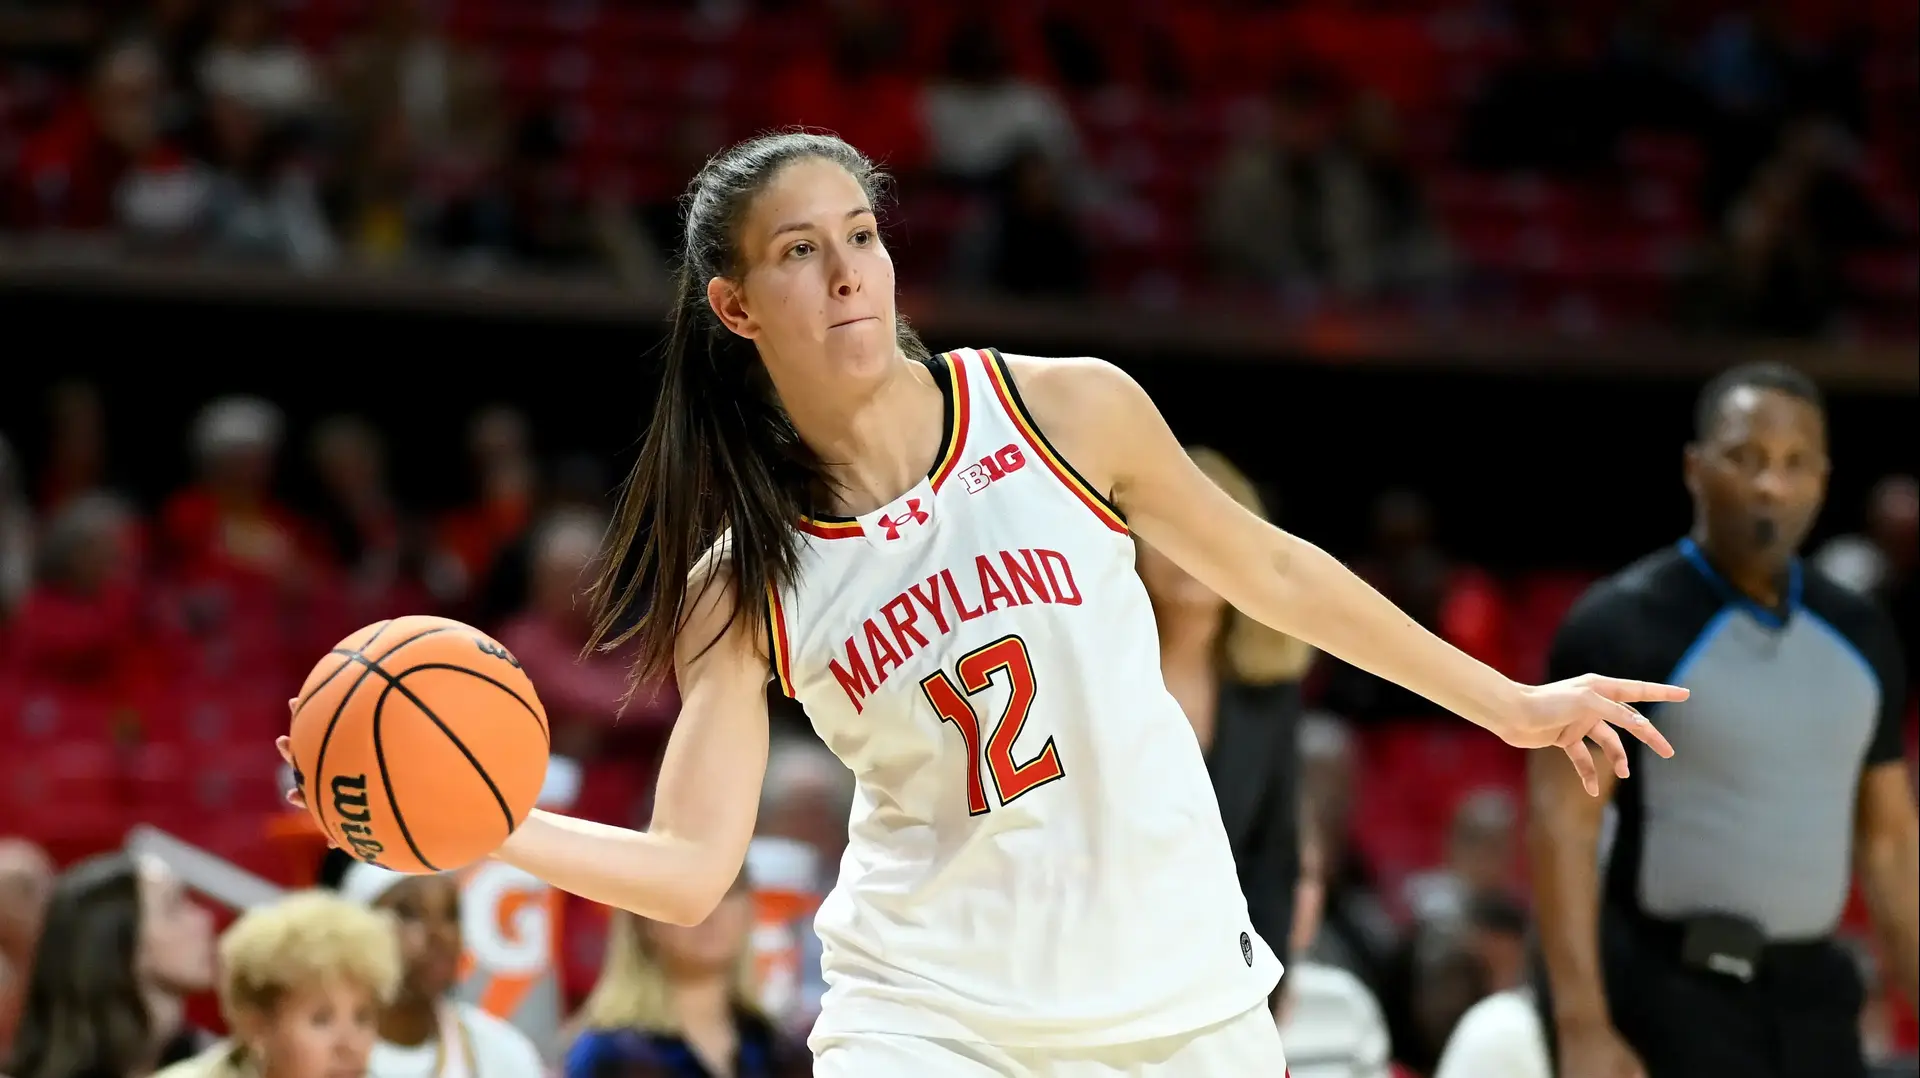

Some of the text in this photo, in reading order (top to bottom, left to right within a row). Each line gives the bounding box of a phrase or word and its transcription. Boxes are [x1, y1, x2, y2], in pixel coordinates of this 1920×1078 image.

[828, 548, 1083, 716] MARYLAND
[919, 634, 1065, 816] 12
[463, 863, 549, 971] G
